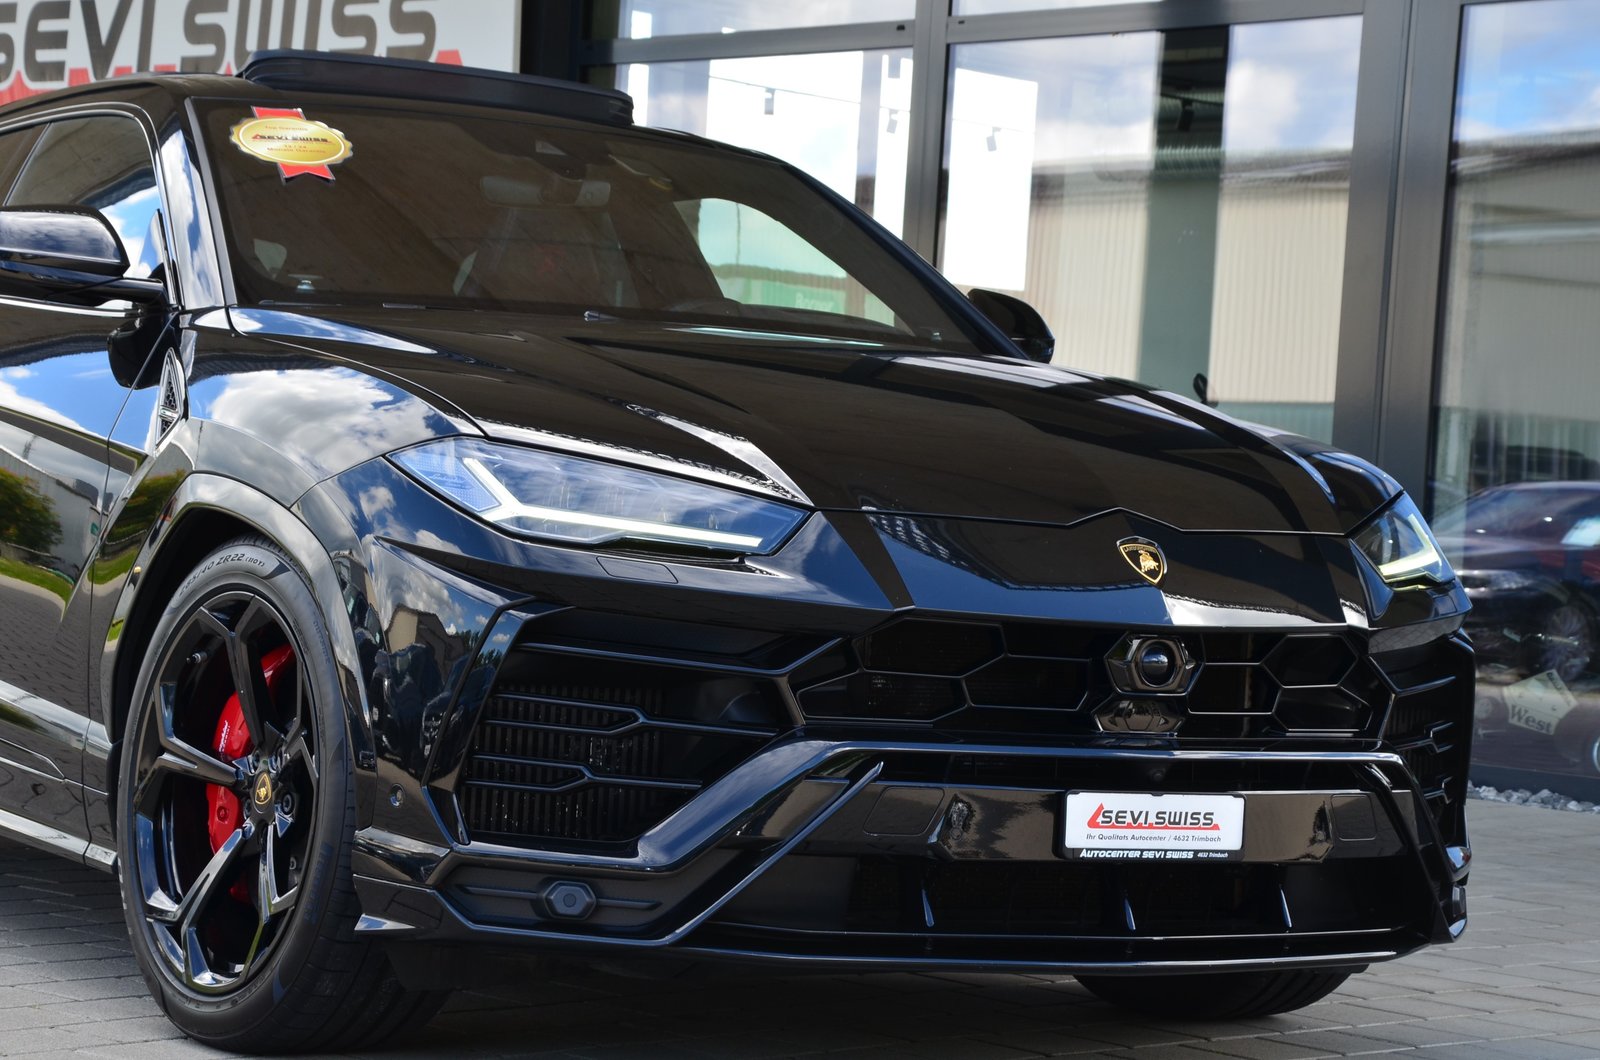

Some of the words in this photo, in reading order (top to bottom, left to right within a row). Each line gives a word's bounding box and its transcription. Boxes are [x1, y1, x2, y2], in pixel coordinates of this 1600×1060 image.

[180, 0, 437, 72] SWISS
[215, 553, 246, 566] ZR22
[1510, 704, 1553, 734] West
[1100, 809, 1150, 826] SEVI
[1154, 811, 1215, 827] SWISS
[1130, 834, 1166, 842] Autocenter
[1191, 835, 1222, 843] Trimbach
[1141, 850, 1165, 860] SEVI
[1165, 850, 1195, 860] SWISS
